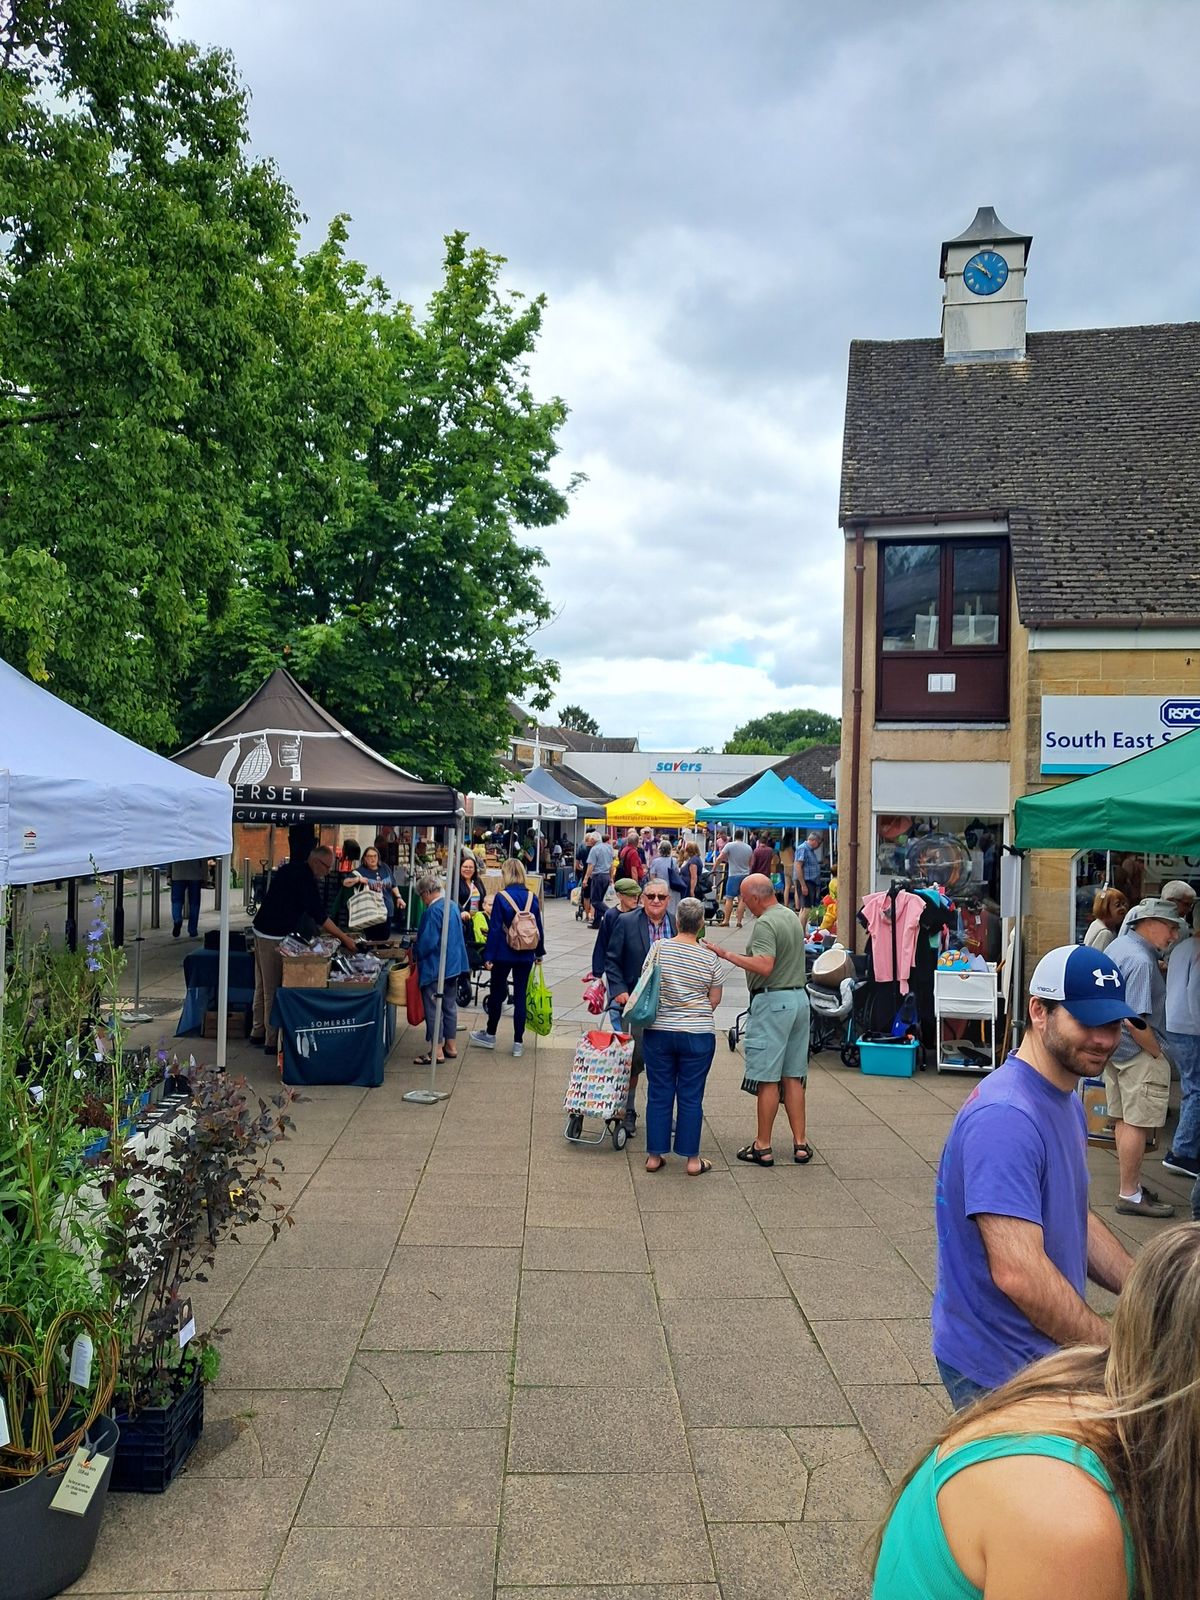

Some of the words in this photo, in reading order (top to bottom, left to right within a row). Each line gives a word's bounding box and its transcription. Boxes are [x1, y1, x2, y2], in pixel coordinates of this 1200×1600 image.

[1168, 707, 1200, 720] RSPC
[1046, 730, 1106, 748] South
[1113, 732, 1155, 749] East
[656, 759, 703, 772] savers
[234, 783, 309, 802] ERSET
[236, 810, 306, 821] CUTERIE
[526, 992, 553, 1009] AIT
[310, 1018, 356, 1028] SOMERSET
